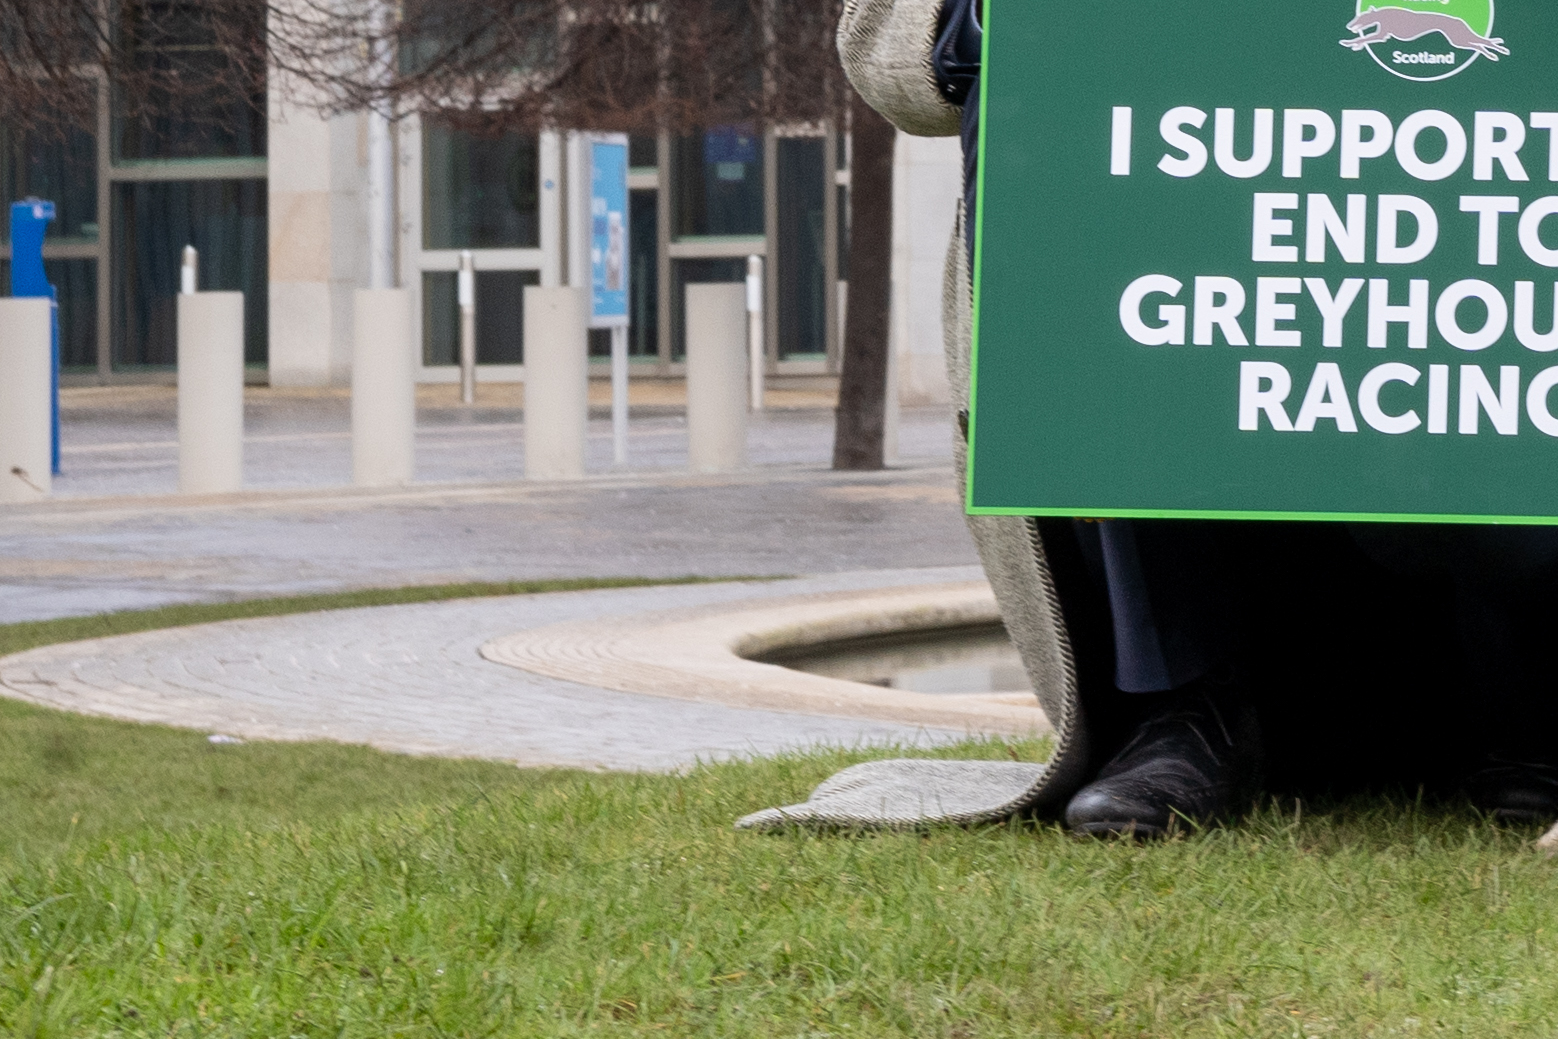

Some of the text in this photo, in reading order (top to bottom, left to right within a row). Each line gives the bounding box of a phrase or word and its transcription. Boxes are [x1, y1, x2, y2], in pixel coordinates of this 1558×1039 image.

[1392, 51, 1455, 64] Scotland
[1110, 106, 1133, 176] I
[1251, 192, 1439, 264] END
